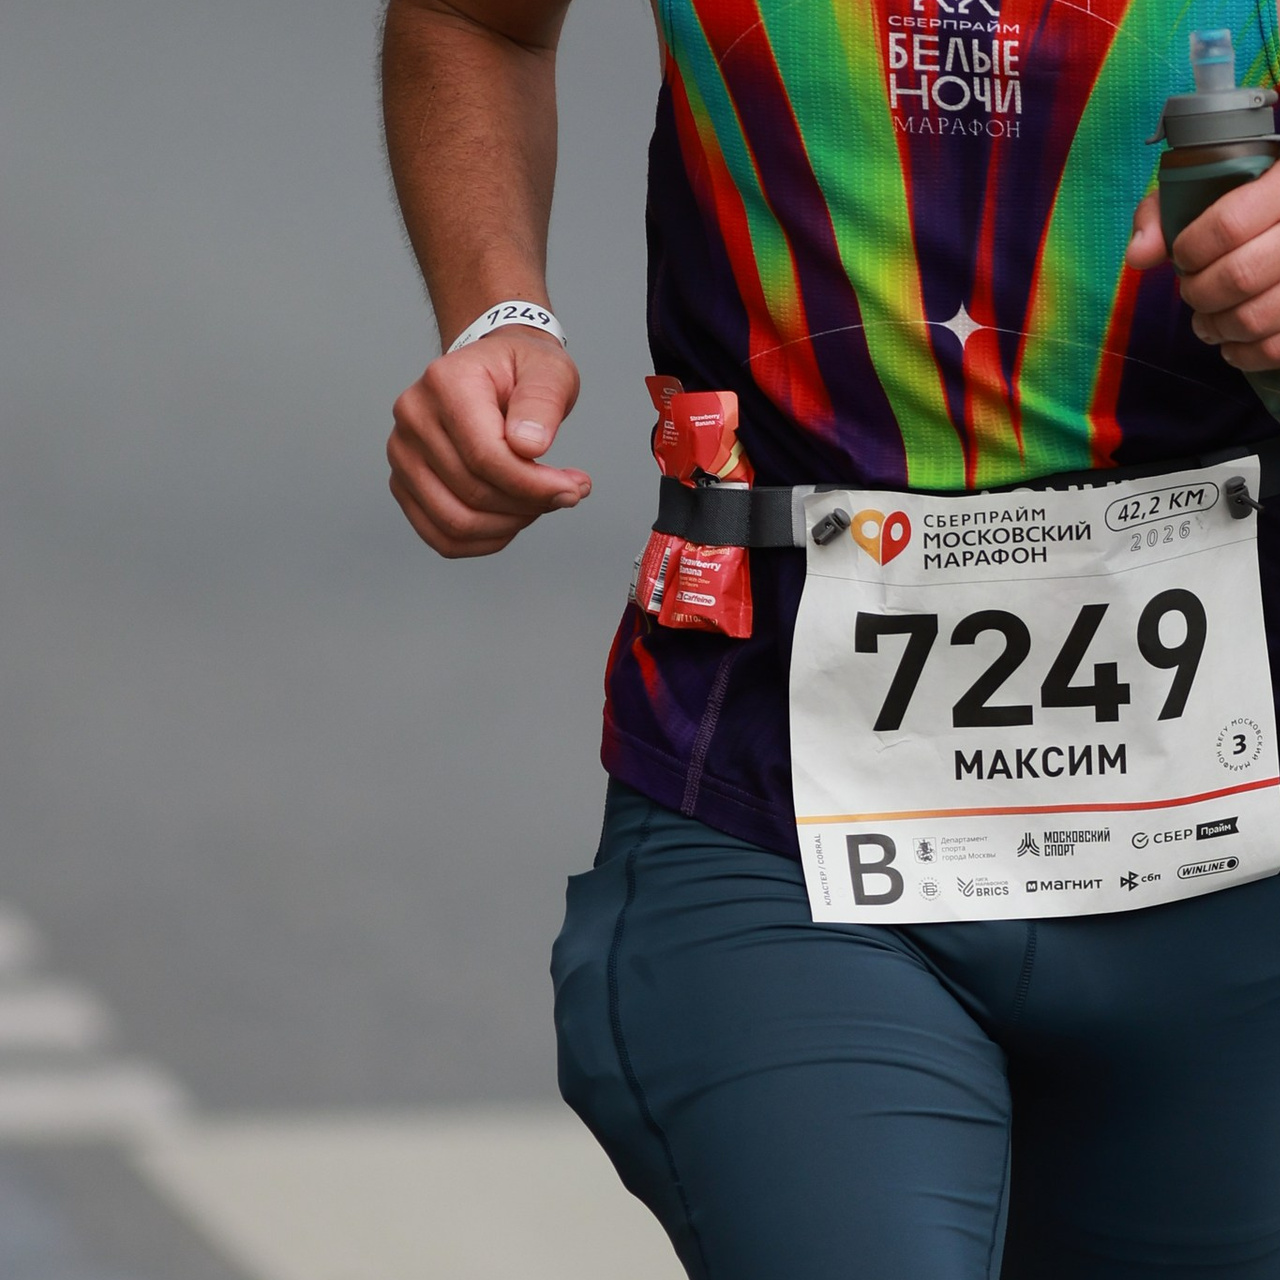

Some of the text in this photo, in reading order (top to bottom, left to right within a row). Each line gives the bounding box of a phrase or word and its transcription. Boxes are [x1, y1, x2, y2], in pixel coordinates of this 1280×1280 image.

[888, 15, 1020, 34] СБЕРПРАЙМ
[888, 32, 1020, 76] БЕЛЫЕ
[889, 73, 1022, 114] НОЧИ
[893, 116, 1020, 138] МАРАФОН
[487, 306, 550, 326] 7249
[690, 414, 720, 422] Strawberry
[923, 507, 1046, 528] СБЕРПРАЙМ
[1117, 496, 1161, 522] 42,2
[923, 521, 1091, 549] МОСКОВСКИЙ
[1131, 521, 1190, 551] 2026
[680, 556, 721, 572] Strawberry
[923, 546, 1047, 570] МАРАФОН
[683, 593, 712, 604] Caffeine
[854, 588, 1207, 732] 7249
[1233, 734, 1246, 755] 3
[954, 744, 1127, 780] МАКСИМ
[941, 836, 988, 845] Департамент
[1044, 827, 1111, 844] МОСКОВСКИЙ
[1153, 822, 1231, 844] СБЕР Прайм
[1044, 844, 1075, 857] СПОРТ
[1141, 873, 1161, 883] сбп
[1182, 861, 1226, 876] WINLINE
[820, 871, 832, 906] КЛАСТЕР
[976, 886, 1009, 897] BRICS
